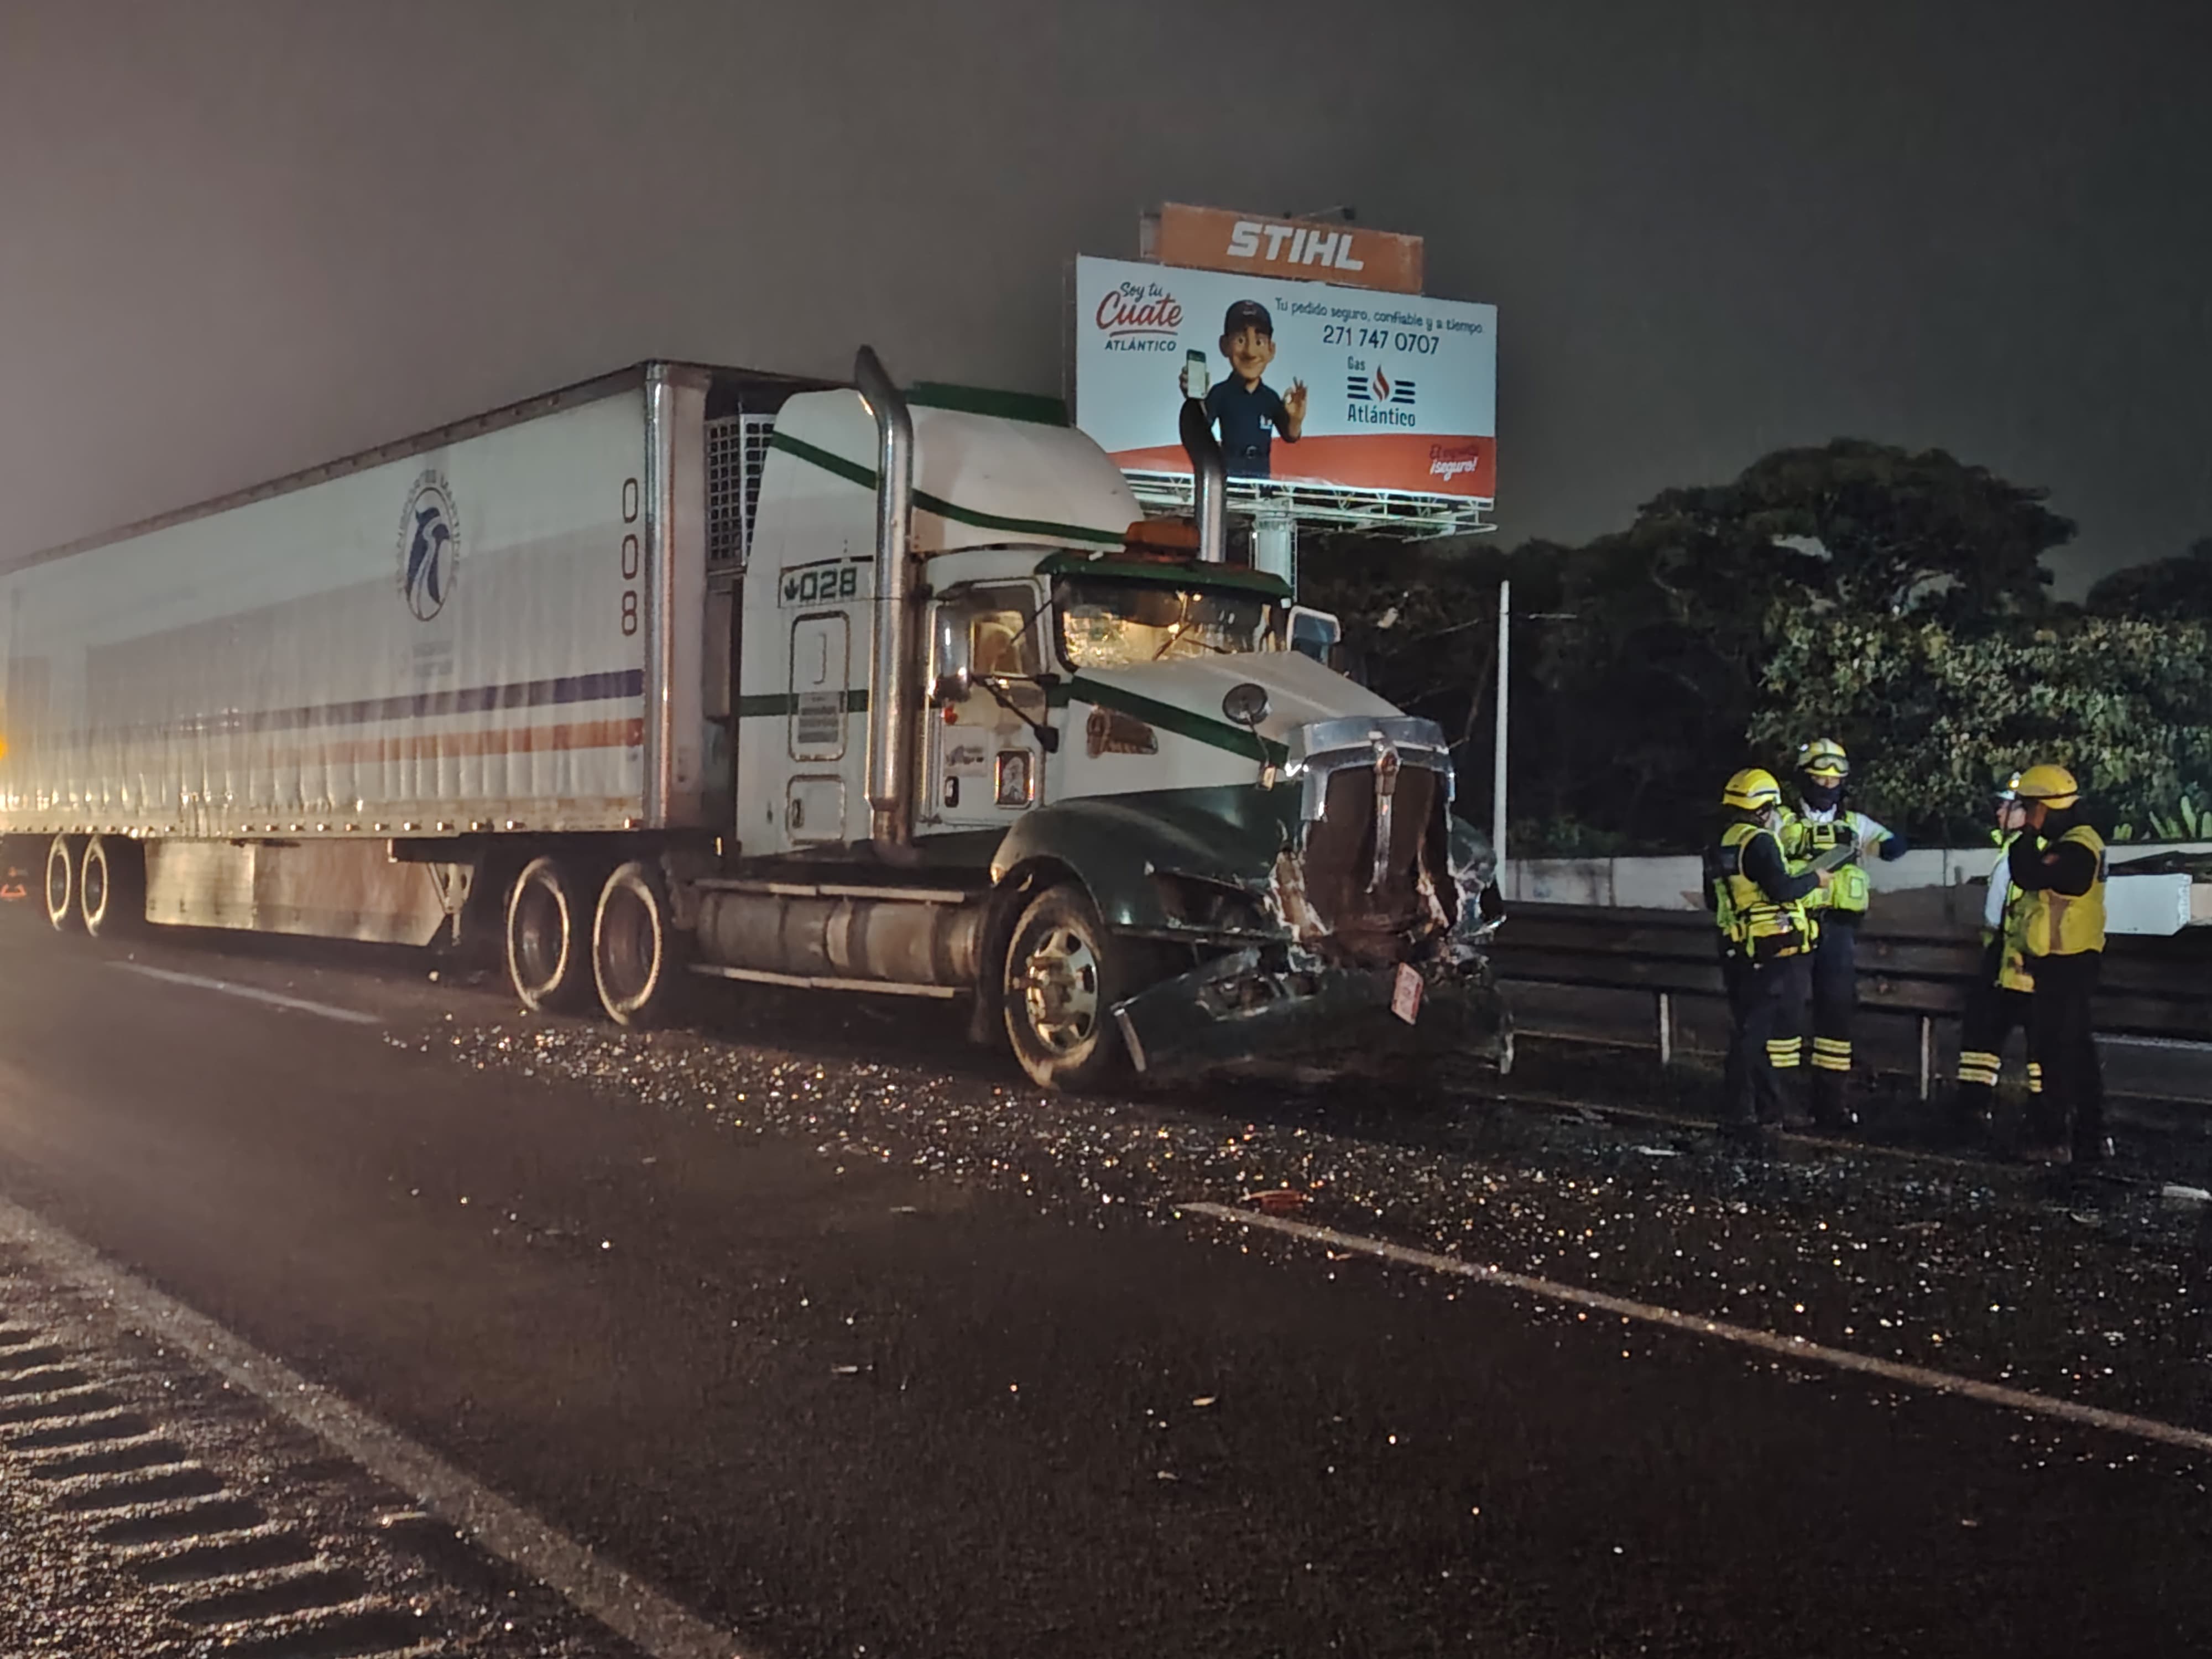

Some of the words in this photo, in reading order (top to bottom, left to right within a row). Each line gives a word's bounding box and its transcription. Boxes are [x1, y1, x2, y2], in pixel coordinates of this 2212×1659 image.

[1227, 221, 1365, 271] STIHL
[1120, 281, 1145, 303] Soy
[1148, 282, 1163, 297] tu
[1095, 290, 1184, 330] Cuate
[1275, 297, 1288, 311] Tu
[1291, 301, 1327, 316] pedido
[1331, 307, 1371, 322] seguro,
[1373, 311, 1423, 326] confiable
[1426, 317, 1433, 332] y
[1436, 319, 1443, 329] a
[1446, 318, 1483, 335] tiempo
[1105, 336, 1177, 352] ATLÁNTICO
[1323, 325, 1352, 346] 271
[1359, 328, 1389, 349] 747
[1395, 332, 1439, 355] 0707
[1347, 356, 1365, 371] Gas
[1347, 403, 1416, 427] Atlántico
[800, 567, 857, 602] 028
